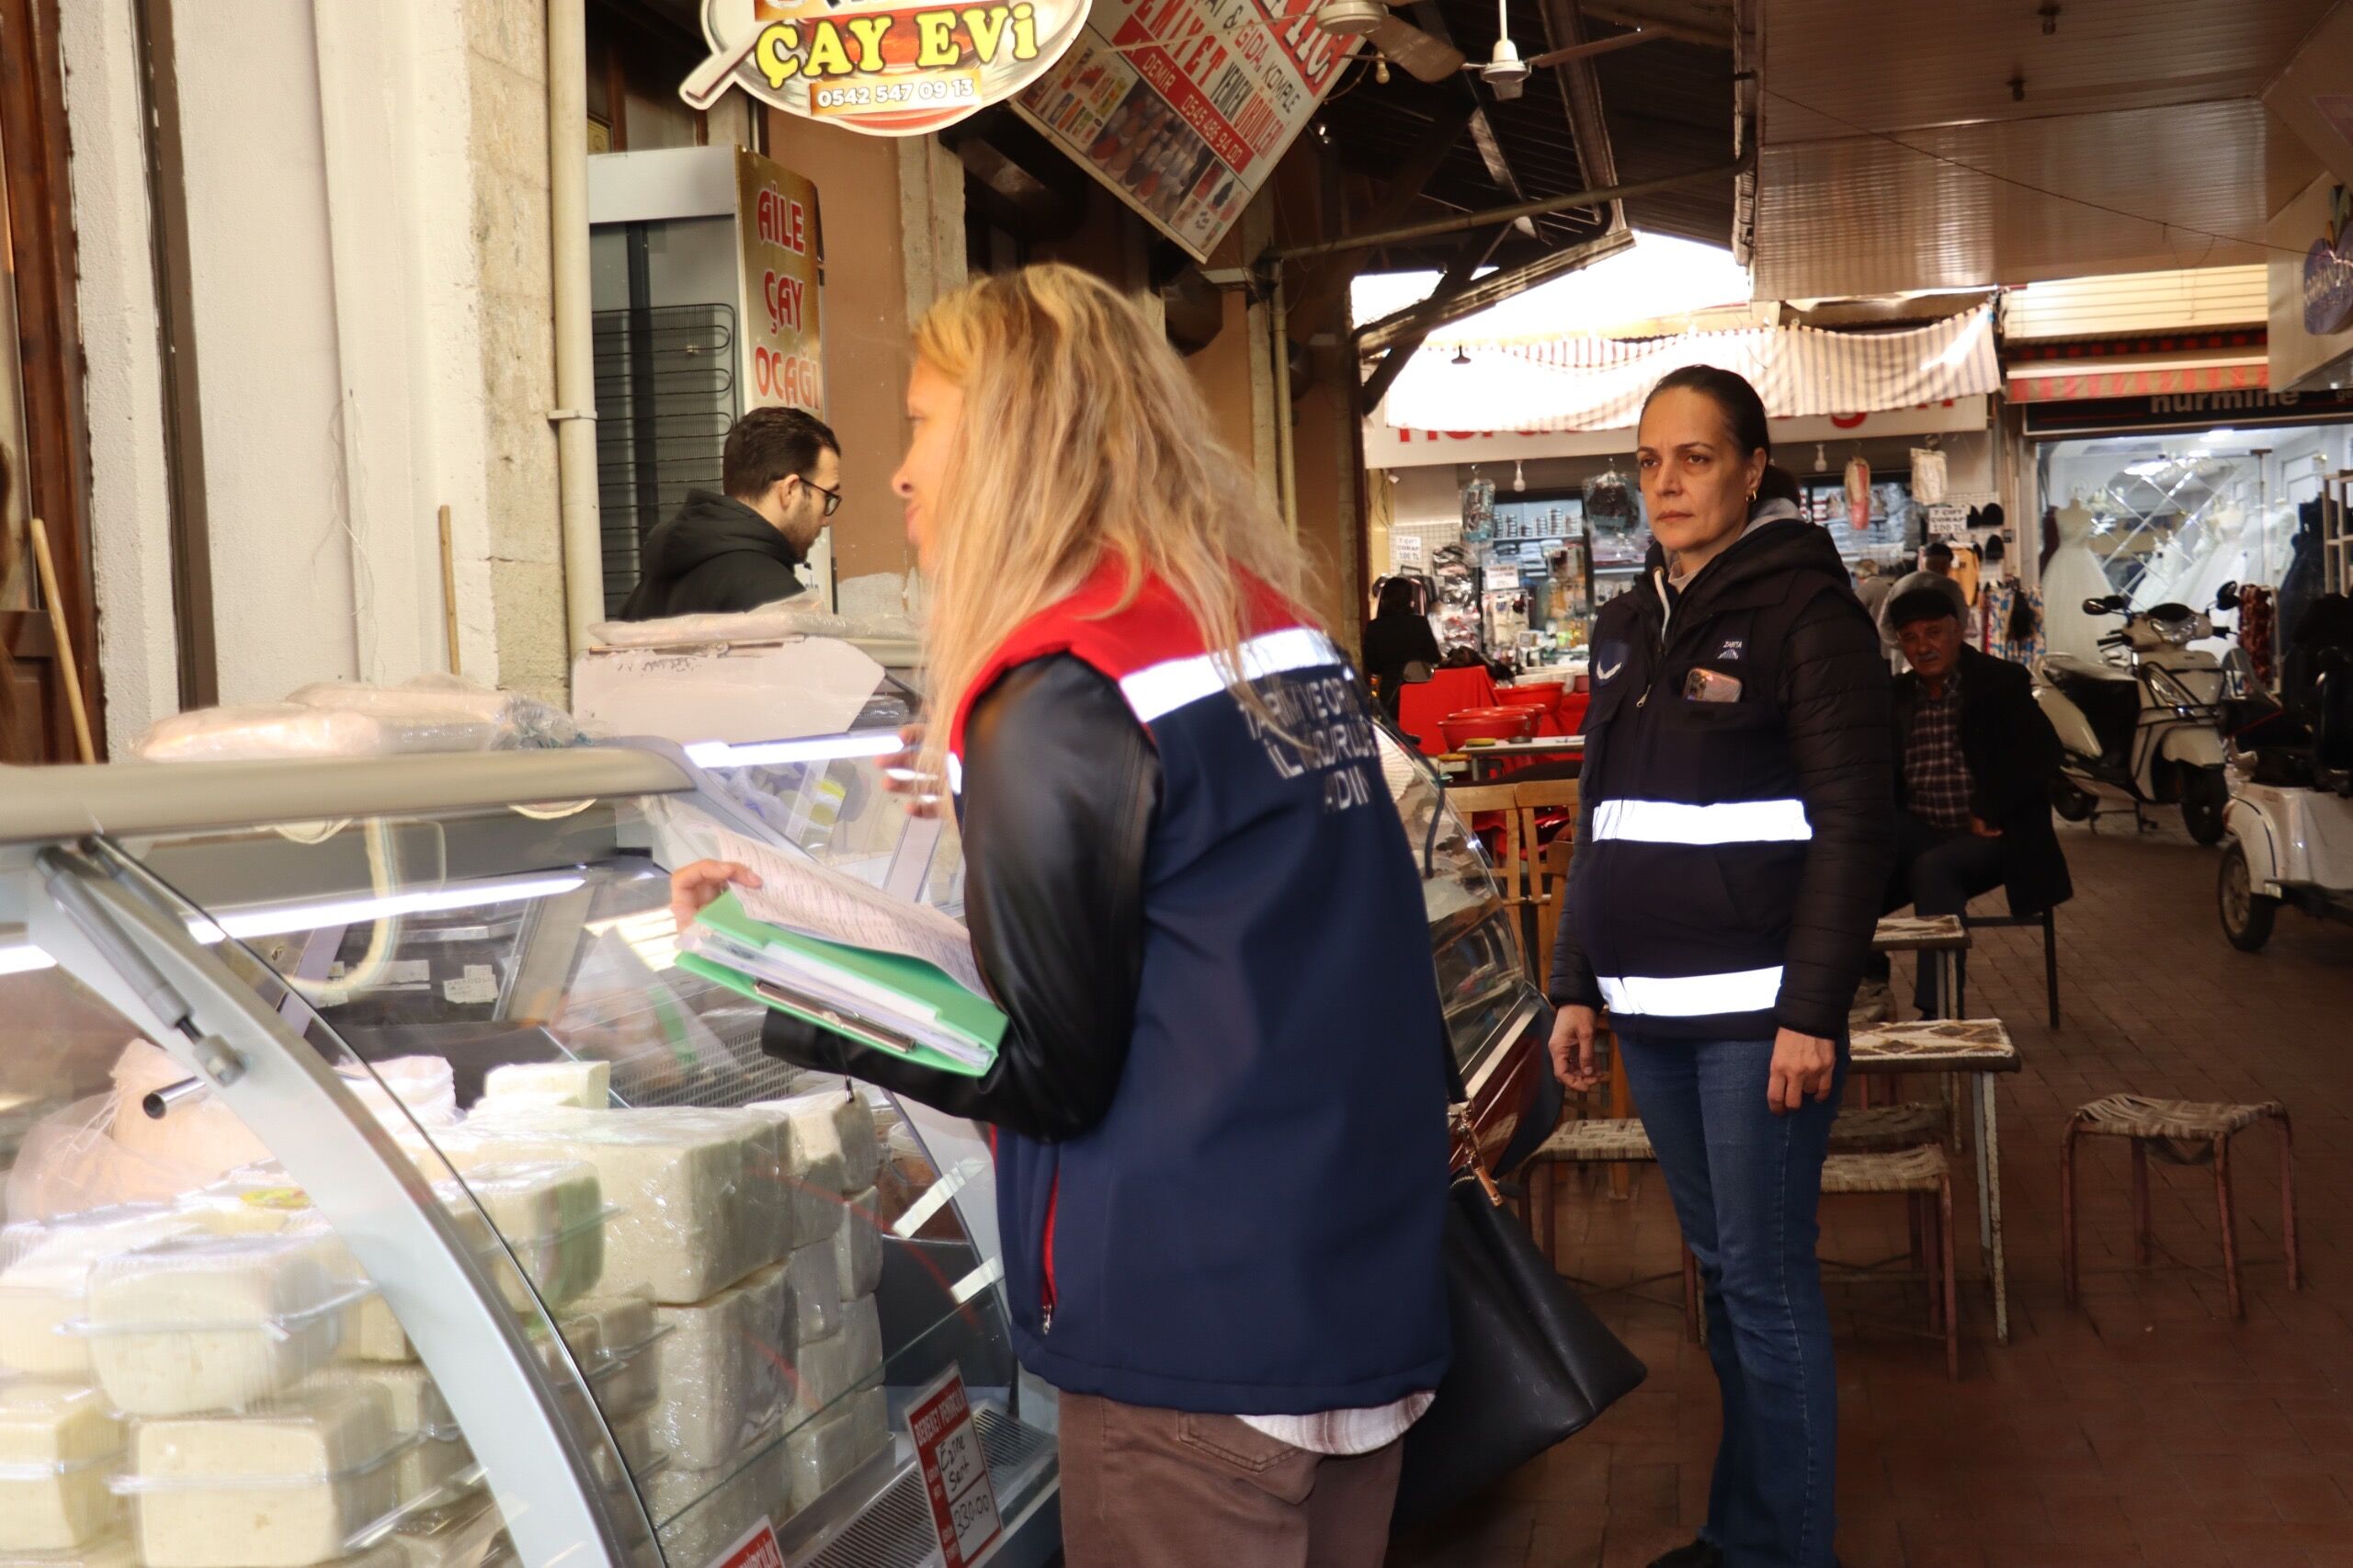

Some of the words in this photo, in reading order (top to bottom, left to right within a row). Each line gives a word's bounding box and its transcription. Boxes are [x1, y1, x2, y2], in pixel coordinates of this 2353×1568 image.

[755, 15, 892, 89] ÇAY
[1142, 52, 1176, 93] DEMİR
[817, 87, 870, 108] 0542
[875, 84, 914, 103] 547
[918, 81, 948, 99] 09
[951, 78, 974, 97] 13
[1210, 62, 1254, 122] YEMEK
[1261, 61, 1301, 114] KOMPLE
[756, 181, 805, 256] AİLE
[764, 269, 804, 335] ÇAY
